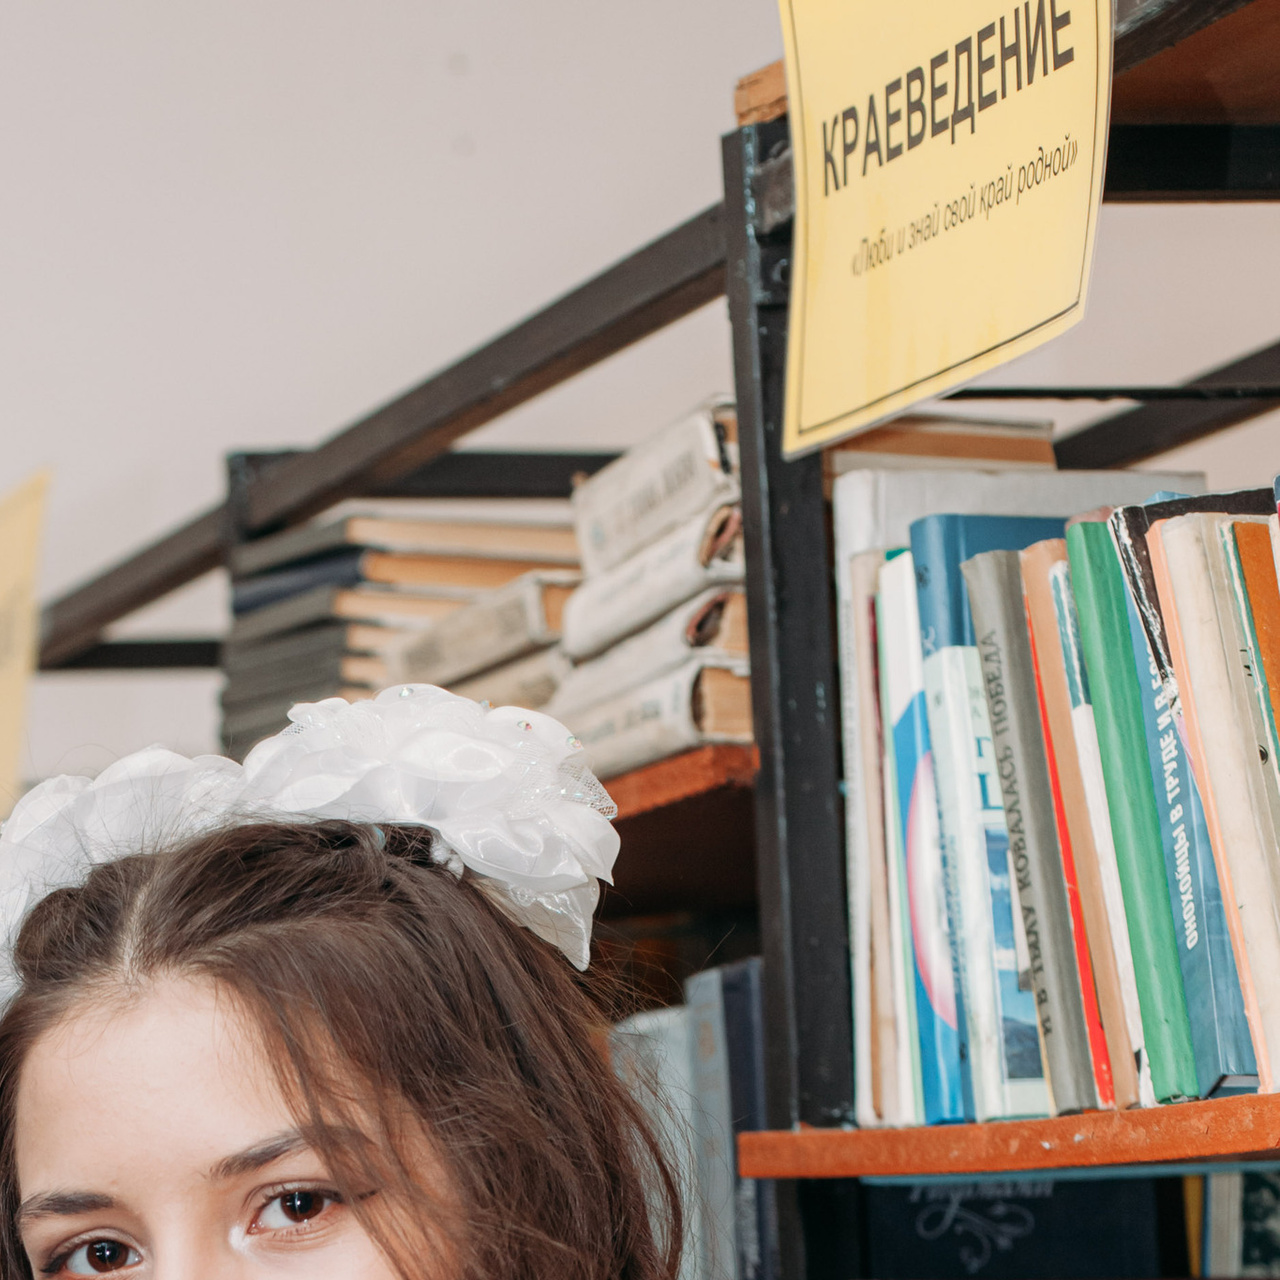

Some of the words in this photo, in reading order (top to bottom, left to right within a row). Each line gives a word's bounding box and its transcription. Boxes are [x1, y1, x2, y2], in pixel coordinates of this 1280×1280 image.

[822, 0, 1074, 197] КРАЕВЕДЕНИЕ
[908, 202, 941, 249] знай
[943, 182, 977, 231] свой
[979, 162, 1014, 221] край
[1016, 132, 1079, 206] родной»
[977, 628, 1010, 737] ПОБЕДА
[1155, 708, 1173, 732] И
[994, 743, 1033, 893] КОВАЛАСЬ
[1158, 729, 1181, 804] ТРУДЕ
[1169, 802, 1184, 825] В
[1019, 903, 1045, 976] ТЫЛУ
[1171, 823, 1200, 950] ОНОХОЙЦЫ
